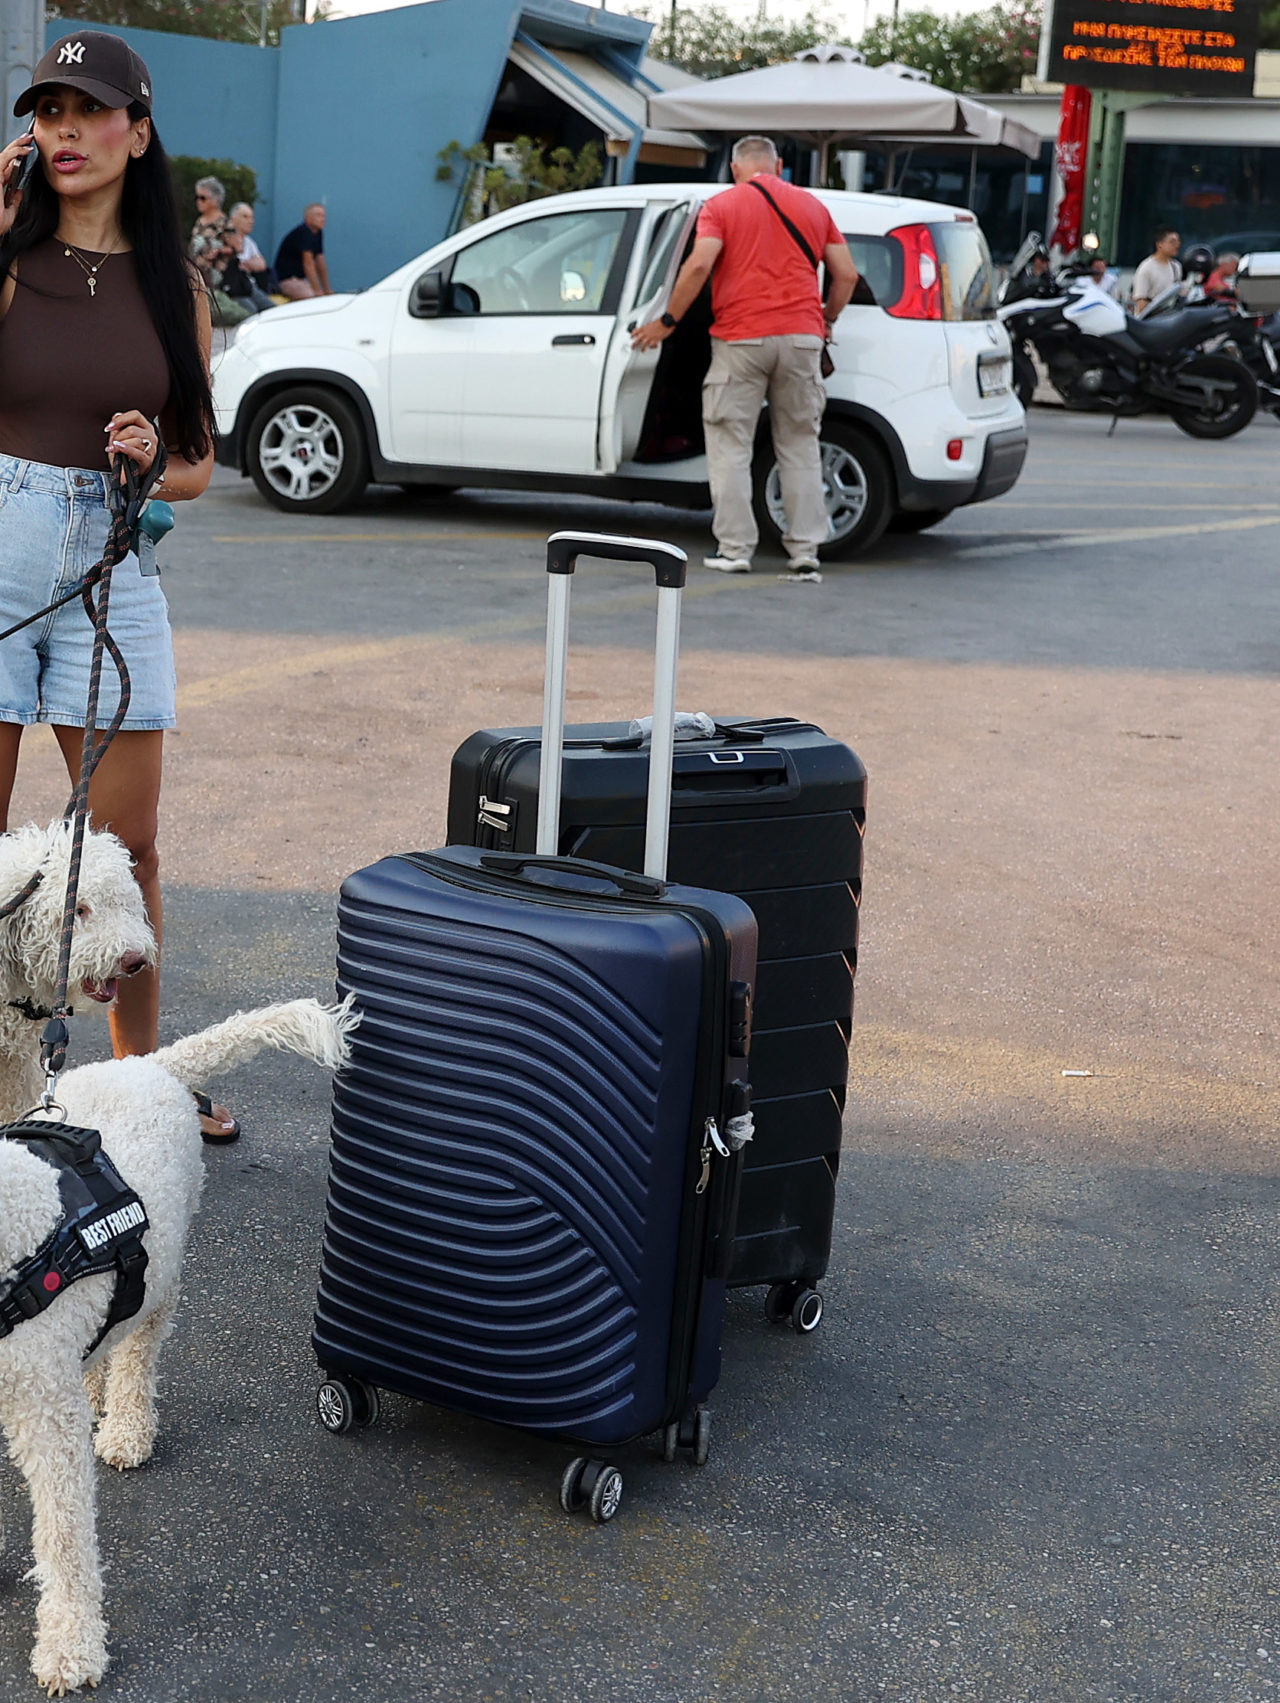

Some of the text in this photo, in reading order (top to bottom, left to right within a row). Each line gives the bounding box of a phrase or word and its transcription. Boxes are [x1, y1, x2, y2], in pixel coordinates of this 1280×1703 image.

[57, 41, 86, 64] NY
[81, 1202, 145, 1250] BEST FRIEND
